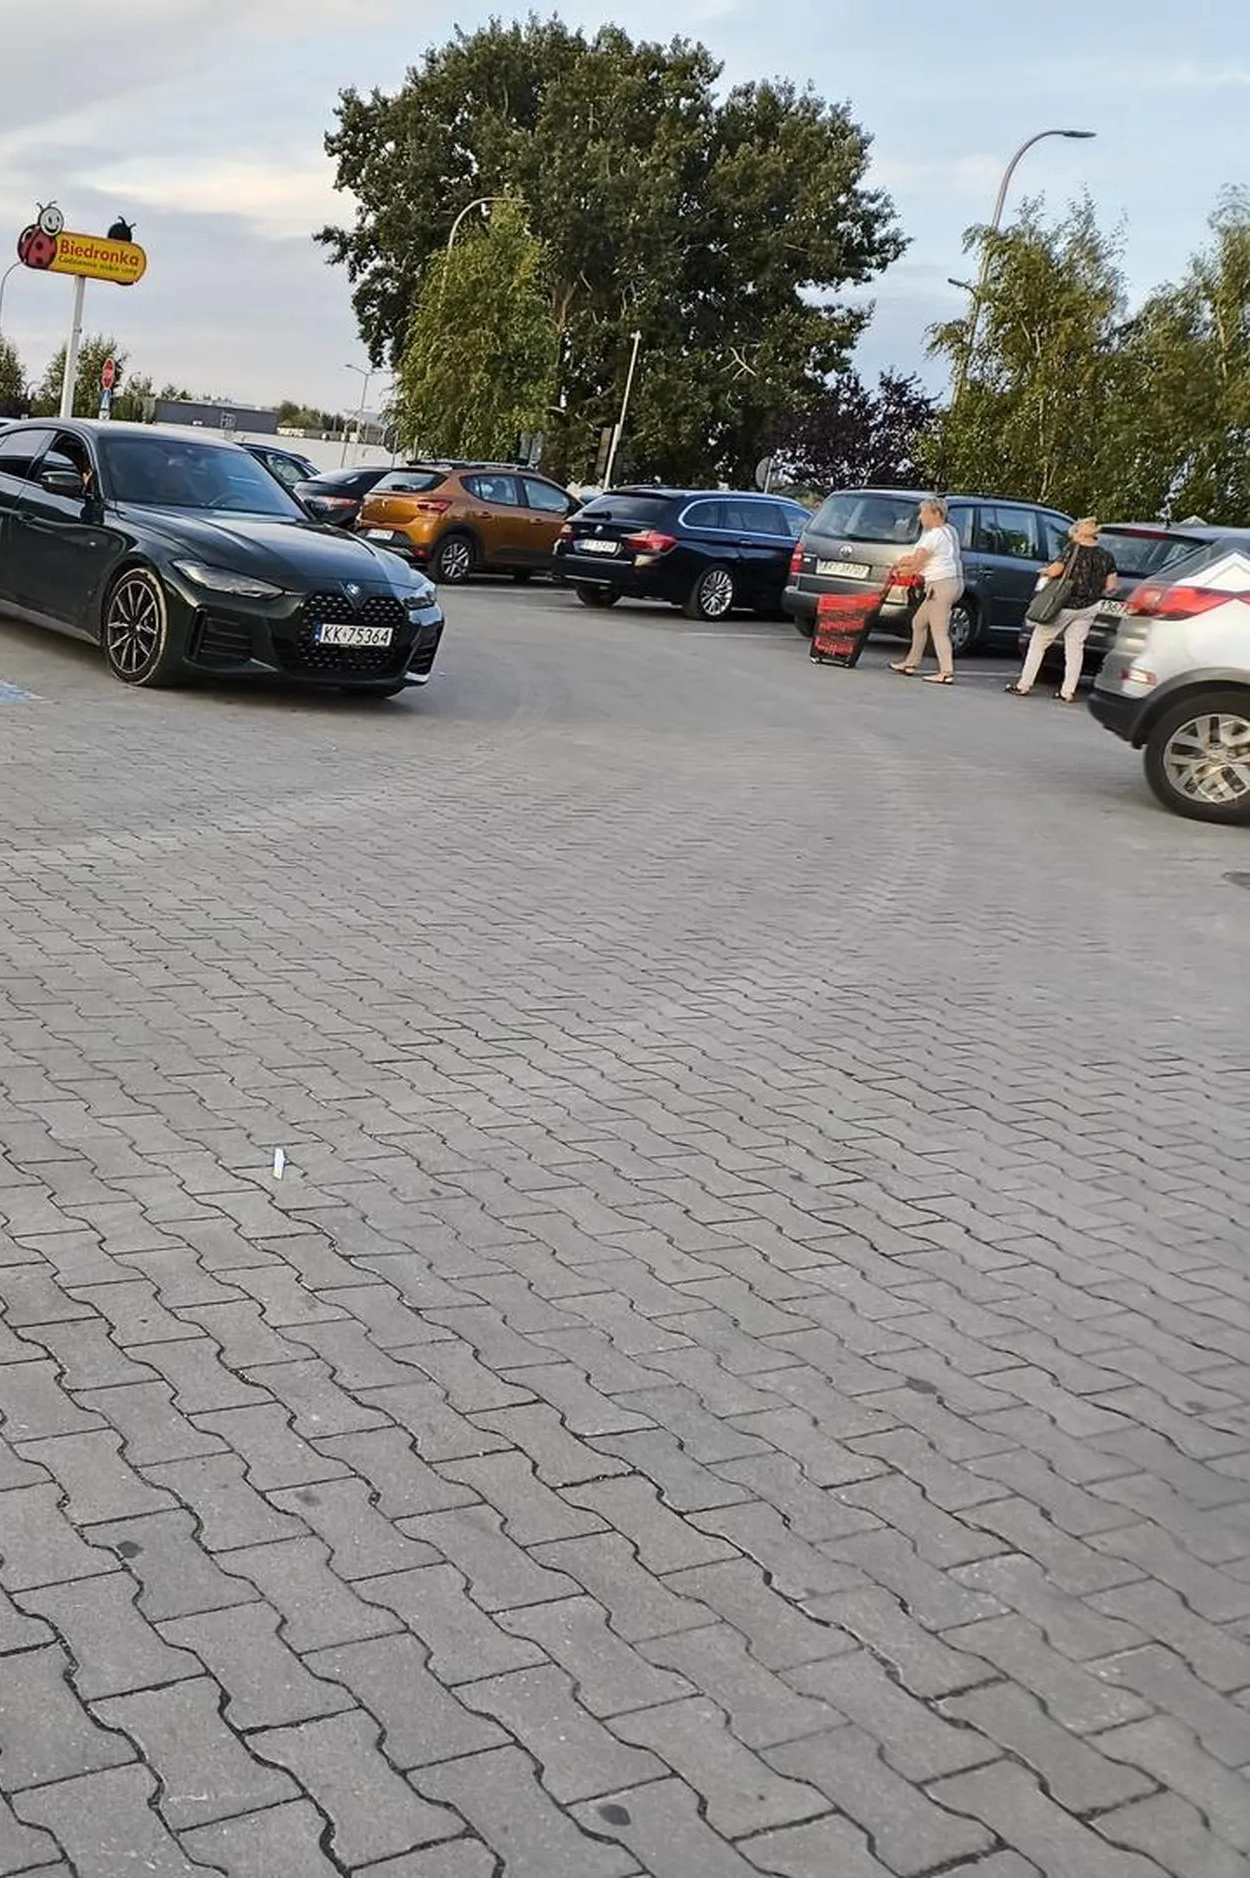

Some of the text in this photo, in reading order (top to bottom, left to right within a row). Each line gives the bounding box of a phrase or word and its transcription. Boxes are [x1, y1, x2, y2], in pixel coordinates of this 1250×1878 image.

[59, 239, 140, 267] Biedronka
[323, 625, 390, 645] KK 75364
